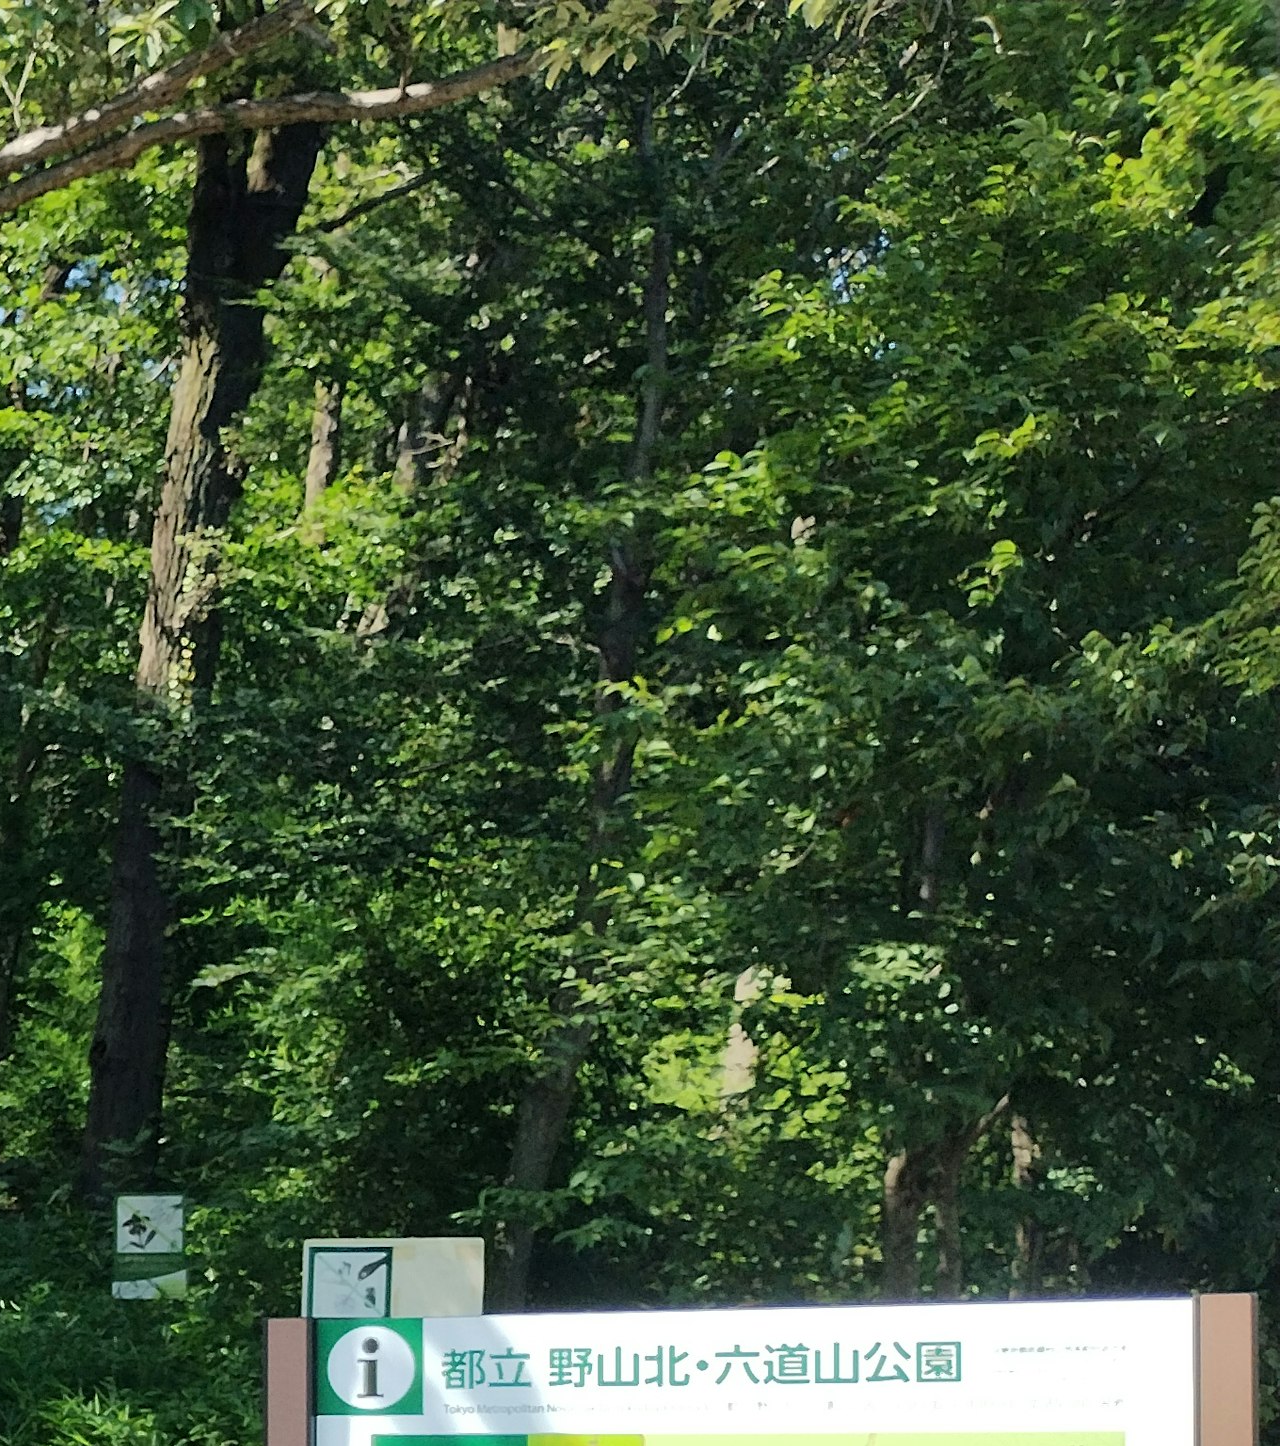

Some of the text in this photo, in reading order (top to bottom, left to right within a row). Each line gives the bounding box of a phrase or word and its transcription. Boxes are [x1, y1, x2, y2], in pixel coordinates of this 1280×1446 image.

[442, 1340, 962, 1390] 都立 野山北・六道山公園
[443, 1403, 475, 1415] Tokyo
[477, 1403, 544, 1414] Metropolitan
